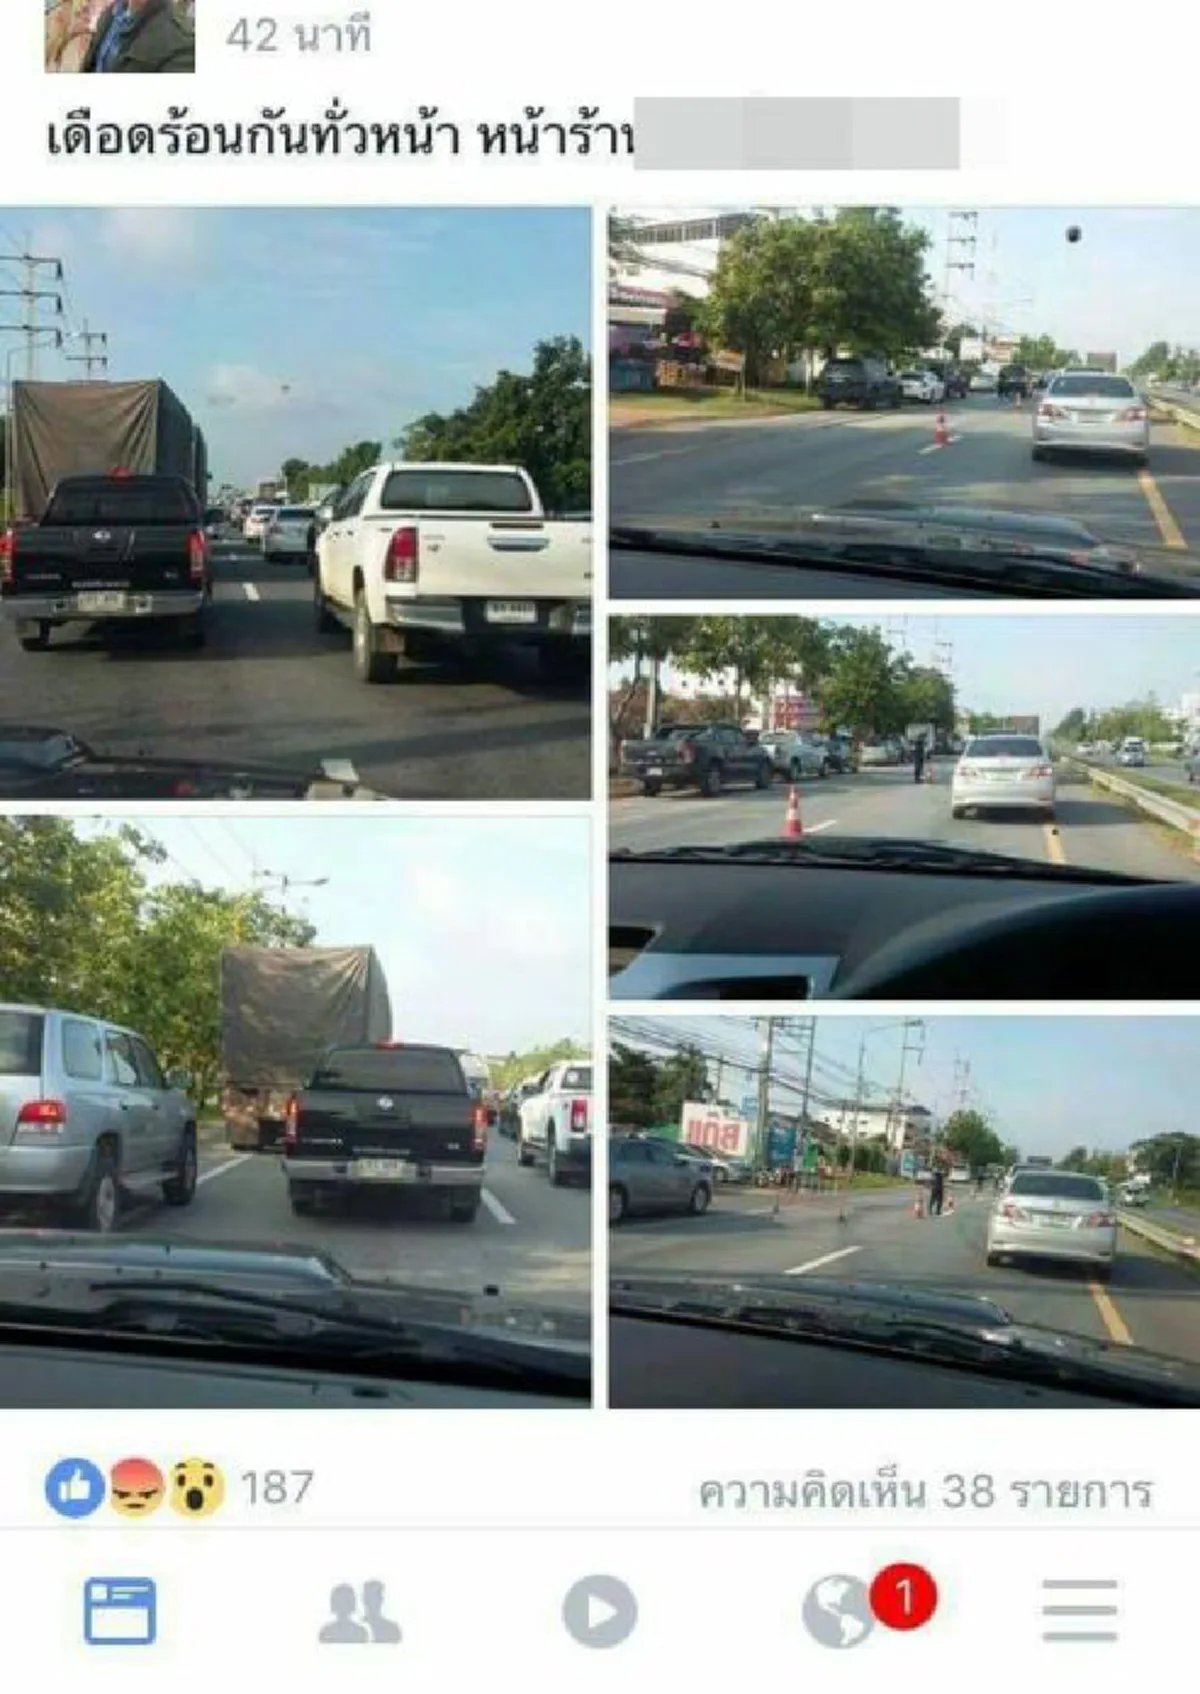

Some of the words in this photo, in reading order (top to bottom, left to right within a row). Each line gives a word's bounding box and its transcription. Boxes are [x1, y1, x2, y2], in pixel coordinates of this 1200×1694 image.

[226, 17, 277, 51] 42
[294, 11, 370, 51] นาที
[48, 97, 459, 154] เดือดร้อนกันทั่วหน้า
[242, 1470, 313, 1504] 187
[699, 1462, 927, 1508] ความคิดเห็น
[943, 1474, 996, 1508] 38
[1010, 1478, 1154, 1508] รายการ
[896, 1578, 912, 1616] 1
